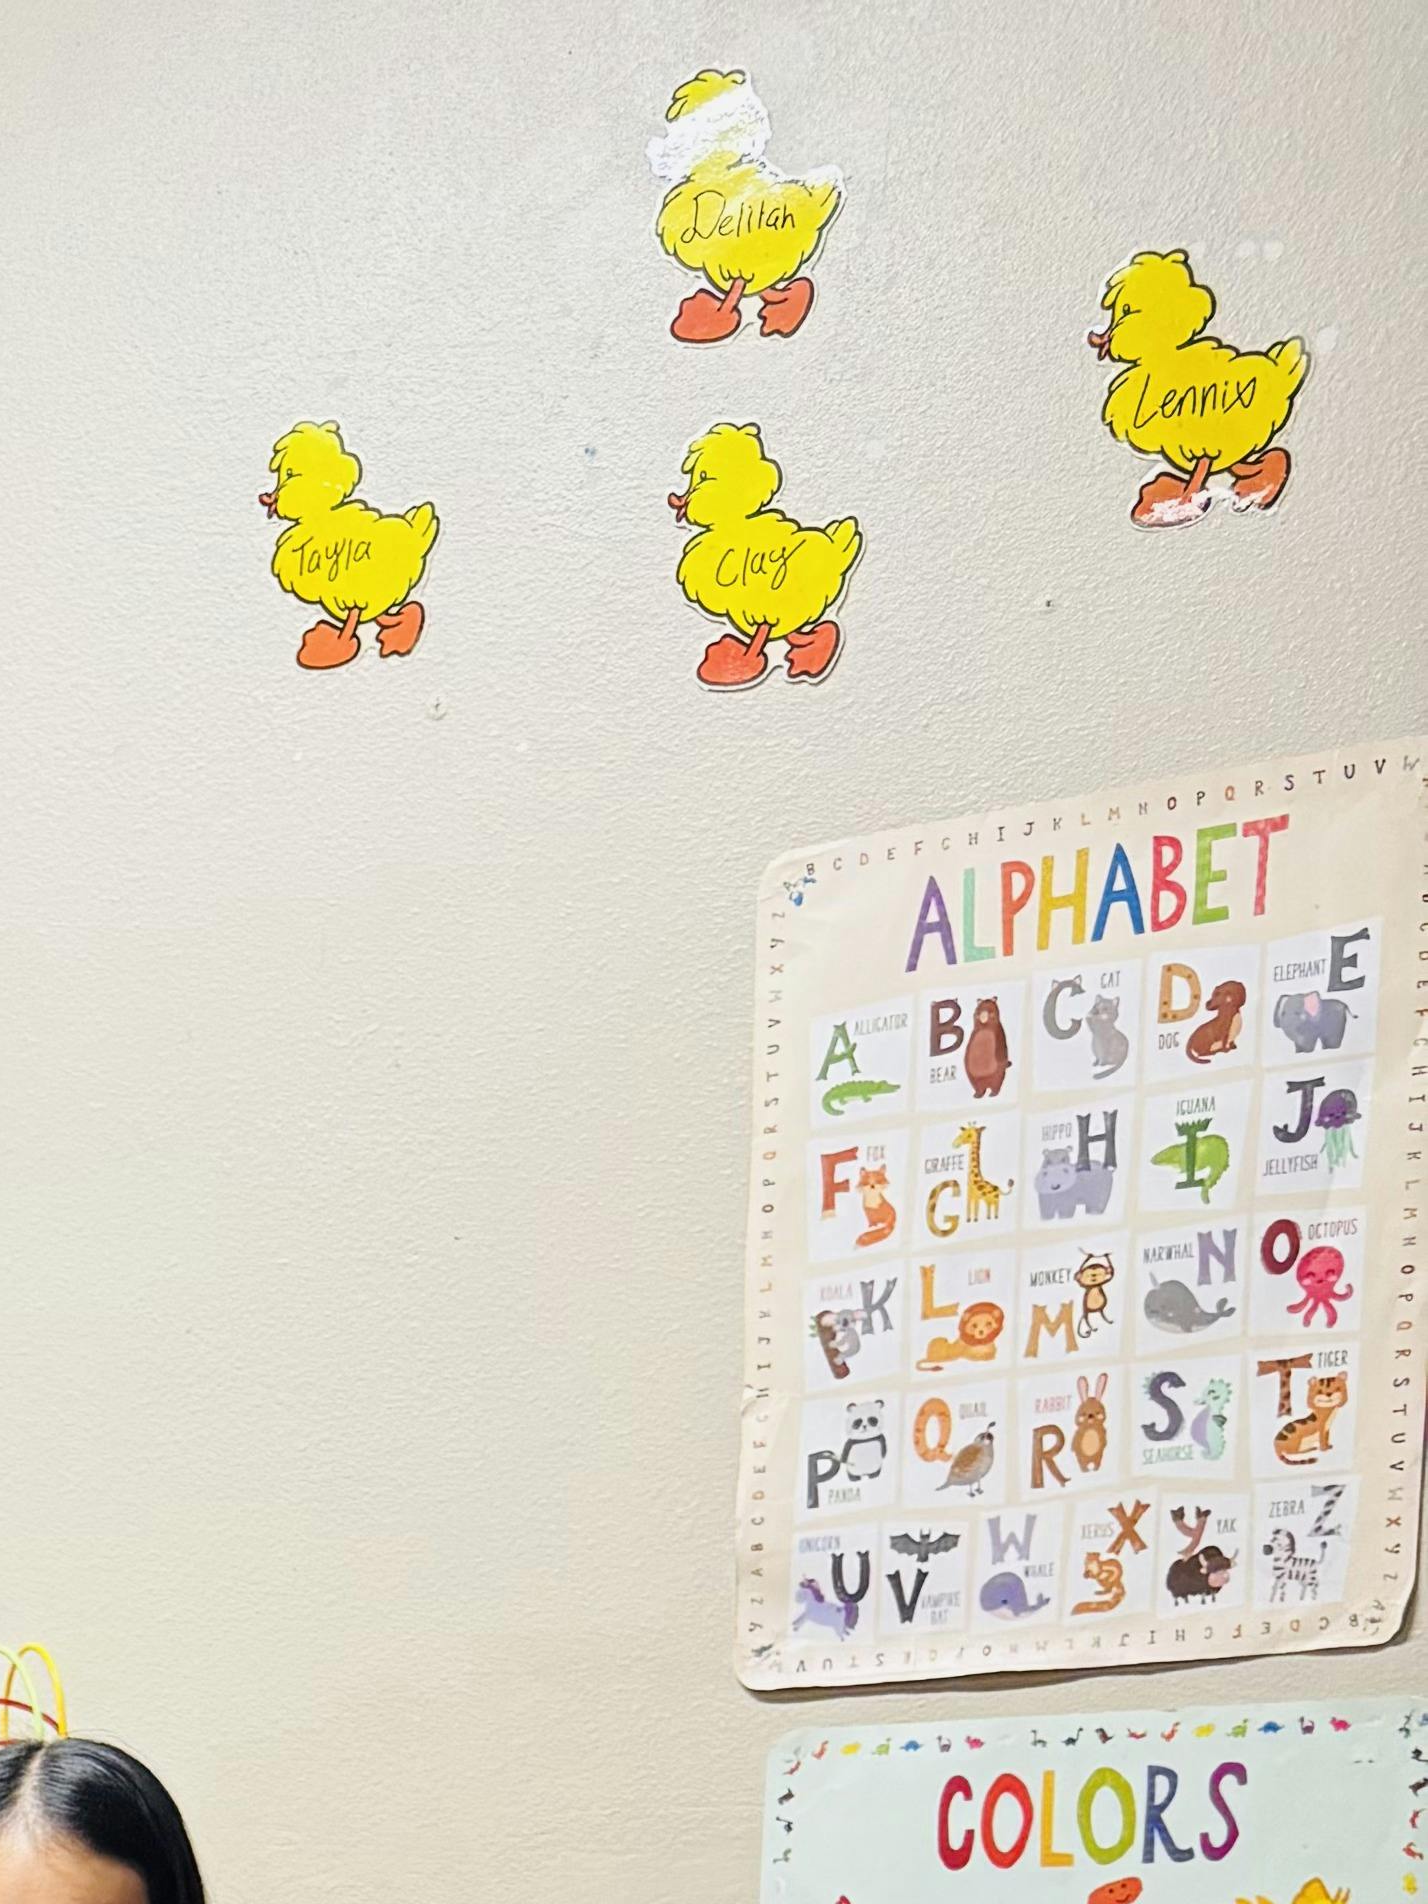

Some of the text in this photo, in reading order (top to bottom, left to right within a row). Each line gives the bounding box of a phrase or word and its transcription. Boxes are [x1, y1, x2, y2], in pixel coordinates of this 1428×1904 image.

[681, 193, 797, 243] Delilah
[292, 535, 373, 576] Tayla
[715, 535, 802, 588] Clay
[905, 814, 1289, 972] ALPHABET
[1100, 971, 1120, 989] CAT
[1274, 959, 1326, 982] ELEPHANT
[1327, 928, 1370, 993] E
[1043, 975, 1085, 1040] C
[1158, 963, 1201, 1023] D
[815, 1021, 861, 1080] A
[854, 1014, 908, 1035] ALLIGATOR
[929, 997, 964, 1057] B
[1159, 1033, 1179, 1049] DOG
[930, 1065, 957, 1083] BEAR
[1042, 1123, 1072, 1140] HIPPO
[1176, 1096, 1216, 1115] IGUANA
[1273, 1077, 1325, 1143] J
[866, 1146, 886, 1163] FOX
[925, 1154, 964, 1174] GIRAFFE
[1076, 1110, 1118, 1171] H
[1175, 1118, 1211, 1190] I
[1264, 1156, 1318, 1176] JELLYFISH
[820, 1147, 858, 1218] F
[925, 1181, 961, 1238] G
[1308, 1220, 1357, 1240] OCTOPUS
[1143, 1242, 1193, 1263] NARWHAL
[1197, 1229, 1237, 1285] N
[1261, 1219, 1301, 1275] O
[920, 1264, 960, 1320] L
[968, 1268, 991, 1285] LION
[1030, 1268, 1072, 1287] MONKEY
[860, 1277, 897, 1335] K
[1025, 1301, 1079, 1358] M
[1257, 1350, 1313, 1417] T
[1318, 1350, 1348, 1368] TIGER
[912, 1397, 952, 1464] Q
[1035, 1395, 1072, 1413] RABBIT
[1142, 1371, 1185, 1442] S
[807, 1451, 840, 1508] P
[1032, 1424, 1071, 1489] R
[1143, 1445, 1194, 1465] SEAHORSE
[1107, 1499, 1150, 1554] X
[1216, 1517, 1236, 1534] YAK
[1270, 1500, 1305, 1518] ZEBRA
[1307, 1484, 1347, 1538] Z
[799, 1534, 840, 1552] UNICORN
[988, 1514, 1037, 1563] W
[831, 1551, 870, 1602] U
[885, 1569, 929, 1624] V
[1024, 1562, 1055, 1578] WHALE
[937, 1762, 1248, 1871] COLORS
